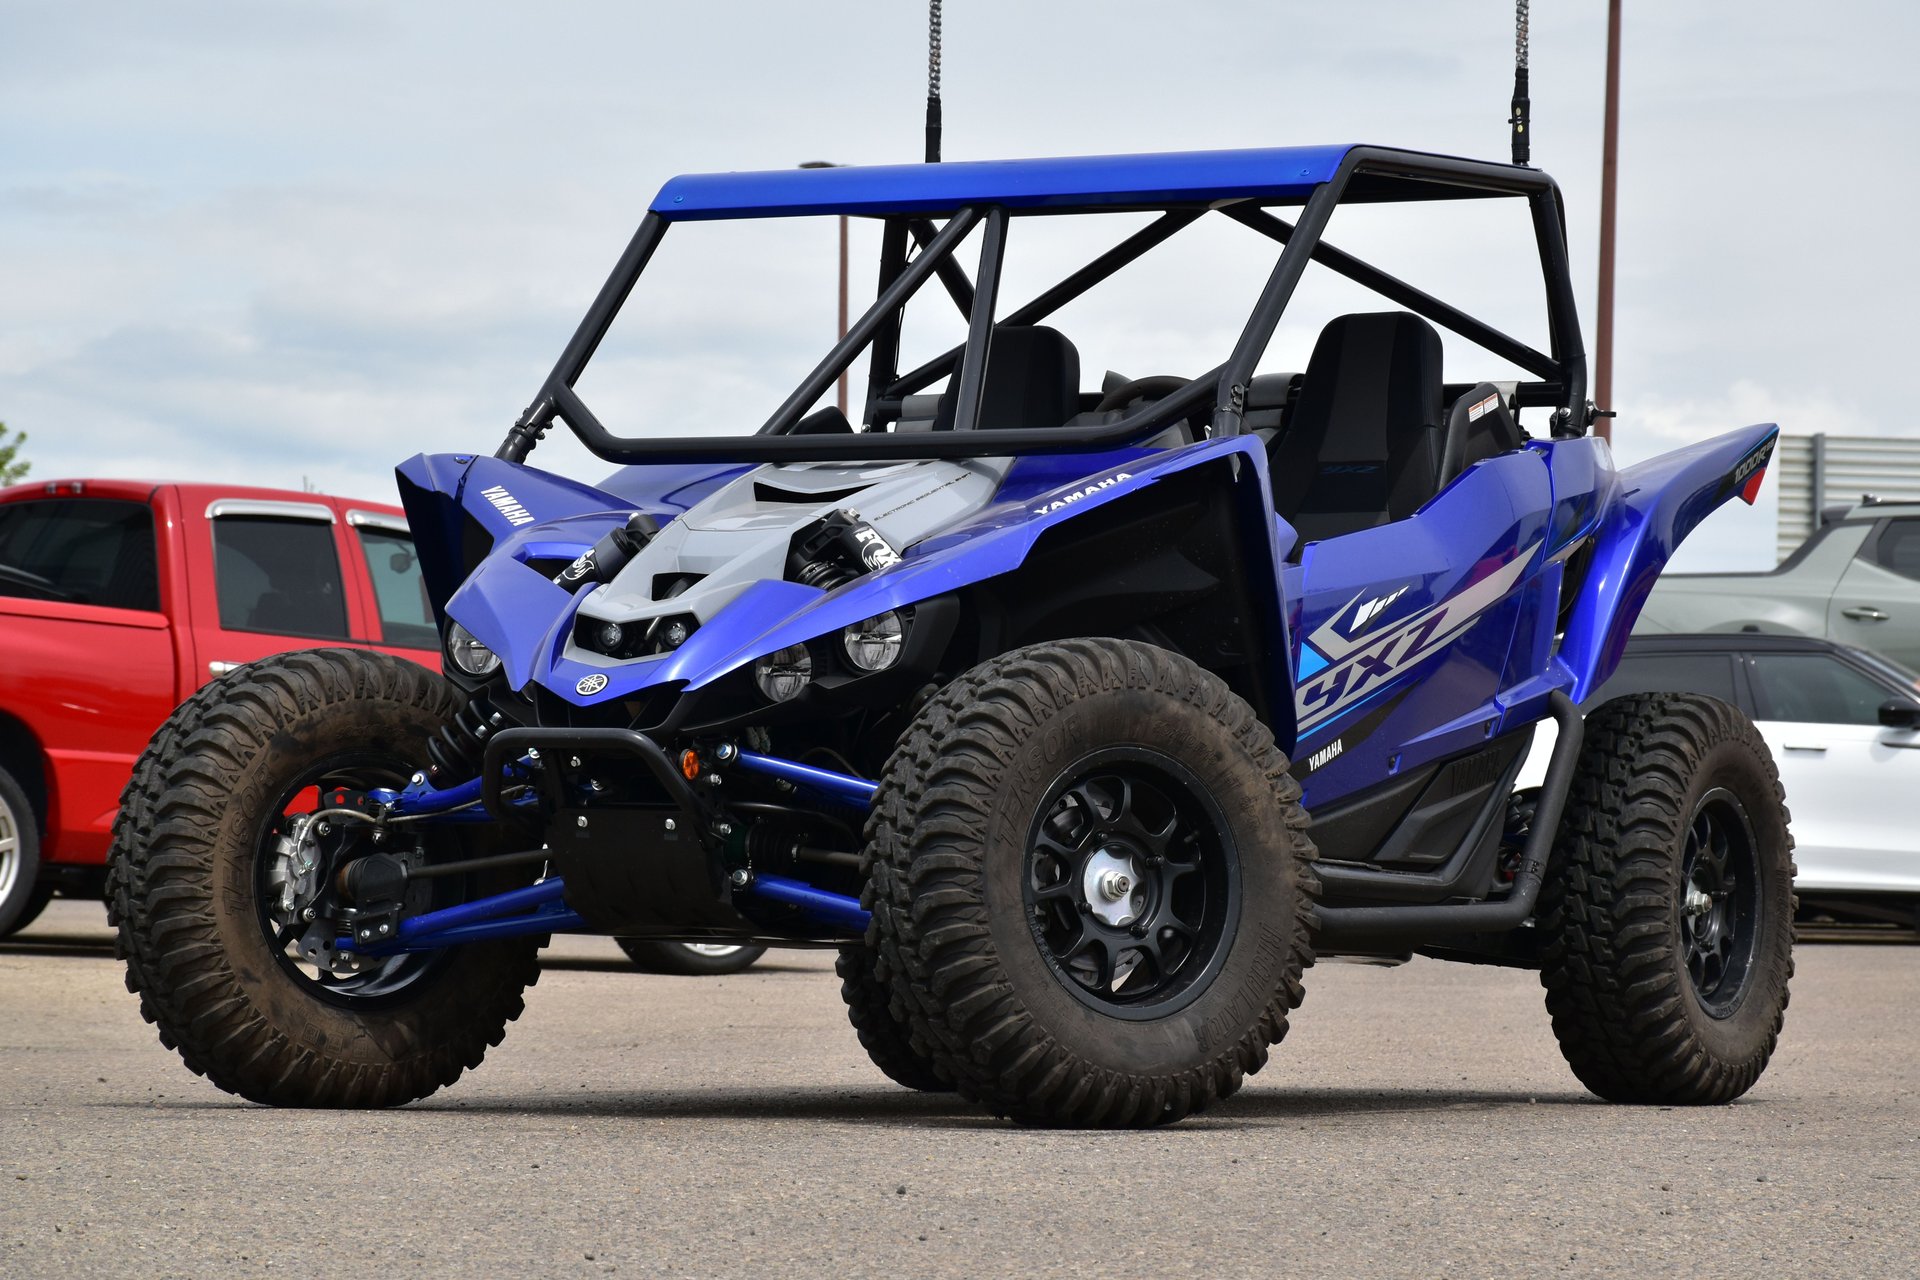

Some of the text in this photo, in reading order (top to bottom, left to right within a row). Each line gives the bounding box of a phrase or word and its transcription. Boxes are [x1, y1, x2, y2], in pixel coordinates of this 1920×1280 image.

[1734, 444, 1766, 484] 1000R
[480, 485, 536, 527] YAMAHA
[874, 499, 915, 521] ELECTRONIC
[915, 482, 955, 501] SEQUENTIAL
[1033, 472, 1132, 515] YAMAHA
[855, 528, 903, 572] FOX
[1309, 738, 1343, 772] YAMAHA
[994, 712, 1083, 848] TENSOR
[222, 761, 274, 916] TENSOR
[1195, 922, 1284, 1053] REGULATOR
